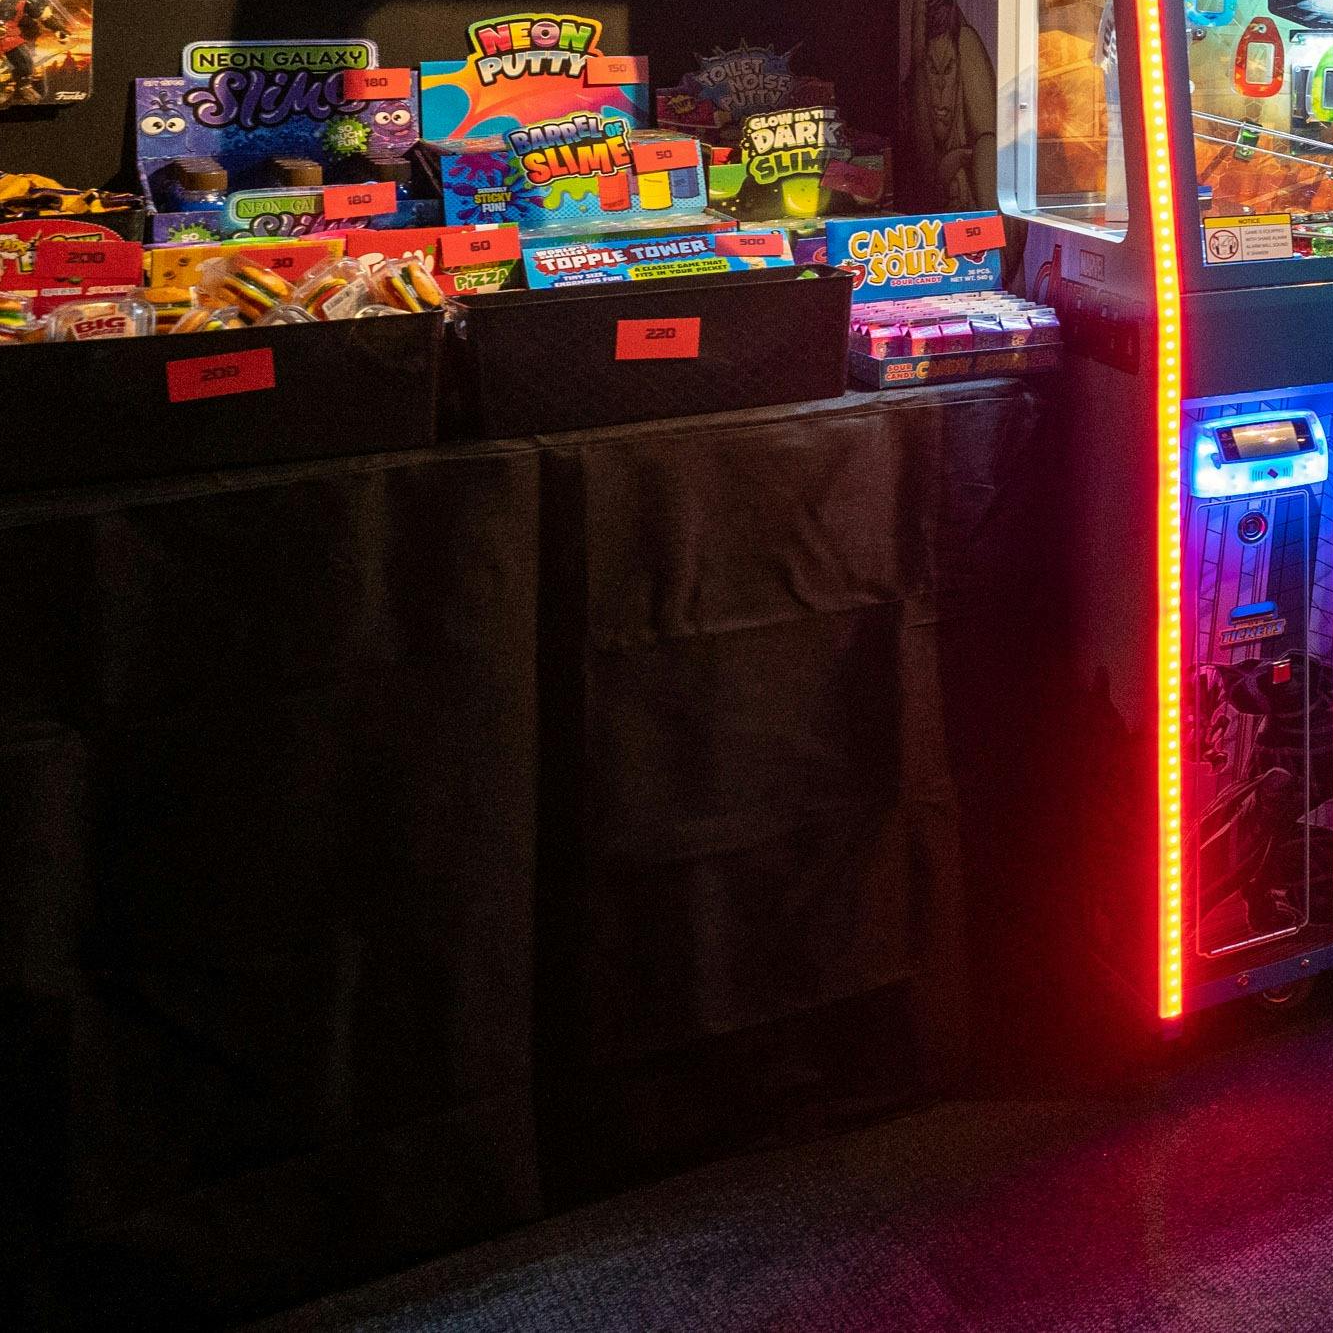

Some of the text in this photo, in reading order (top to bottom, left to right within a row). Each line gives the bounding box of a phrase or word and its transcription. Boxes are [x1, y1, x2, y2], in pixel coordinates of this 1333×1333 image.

[477, 21, 592, 55] NEON
[199, 50, 363, 67] NEON GALAXY
[477, 50, 593, 84] PUTTY
[697, 57, 765, 87] TOILET
[364, 77, 388, 88] 180
[727, 73, 792, 94] NOISE
[720, 89, 783, 112] PUTTY
[750, 111, 811, 130] GLOW IN
[510, 115, 624, 155] BARREL OF
[751, 121, 842, 154] DARK
[523, 135, 632, 184] SLIME
[656, 149, 672, 160] 50
[348, 194, 371, 206] 180
[474, 192, 512, 205] STICKY
[240, 198, 282, 214] NEON
[482, 201, 506, 214] FUN!
[1238, 217, 1260, 225] NOTICE
[966, 226, 981, 237] 50
[470, 240, 491, 252] 60
[740, 238, 765, 246] 500
[849, 219, 943, 259] CANDY
[541, 239, 708, 272] TOPPLE TOWER
[272, 257, 294, 269] 30
[696, 264, 728, 273] POCKET
[698, 259, 723, 267] THAT
[869, 249, 958, 285] SOURS
[891, 277, 942, 287] SOUR CANDY
[74, 316, 126, 334] BIG
[645, 327, 676, 339] 220
[887, 364, 913, 373] SOUR
[886, 371, 916, 381] CANDY
[1220, 619, 1285, 645] TICKETS
